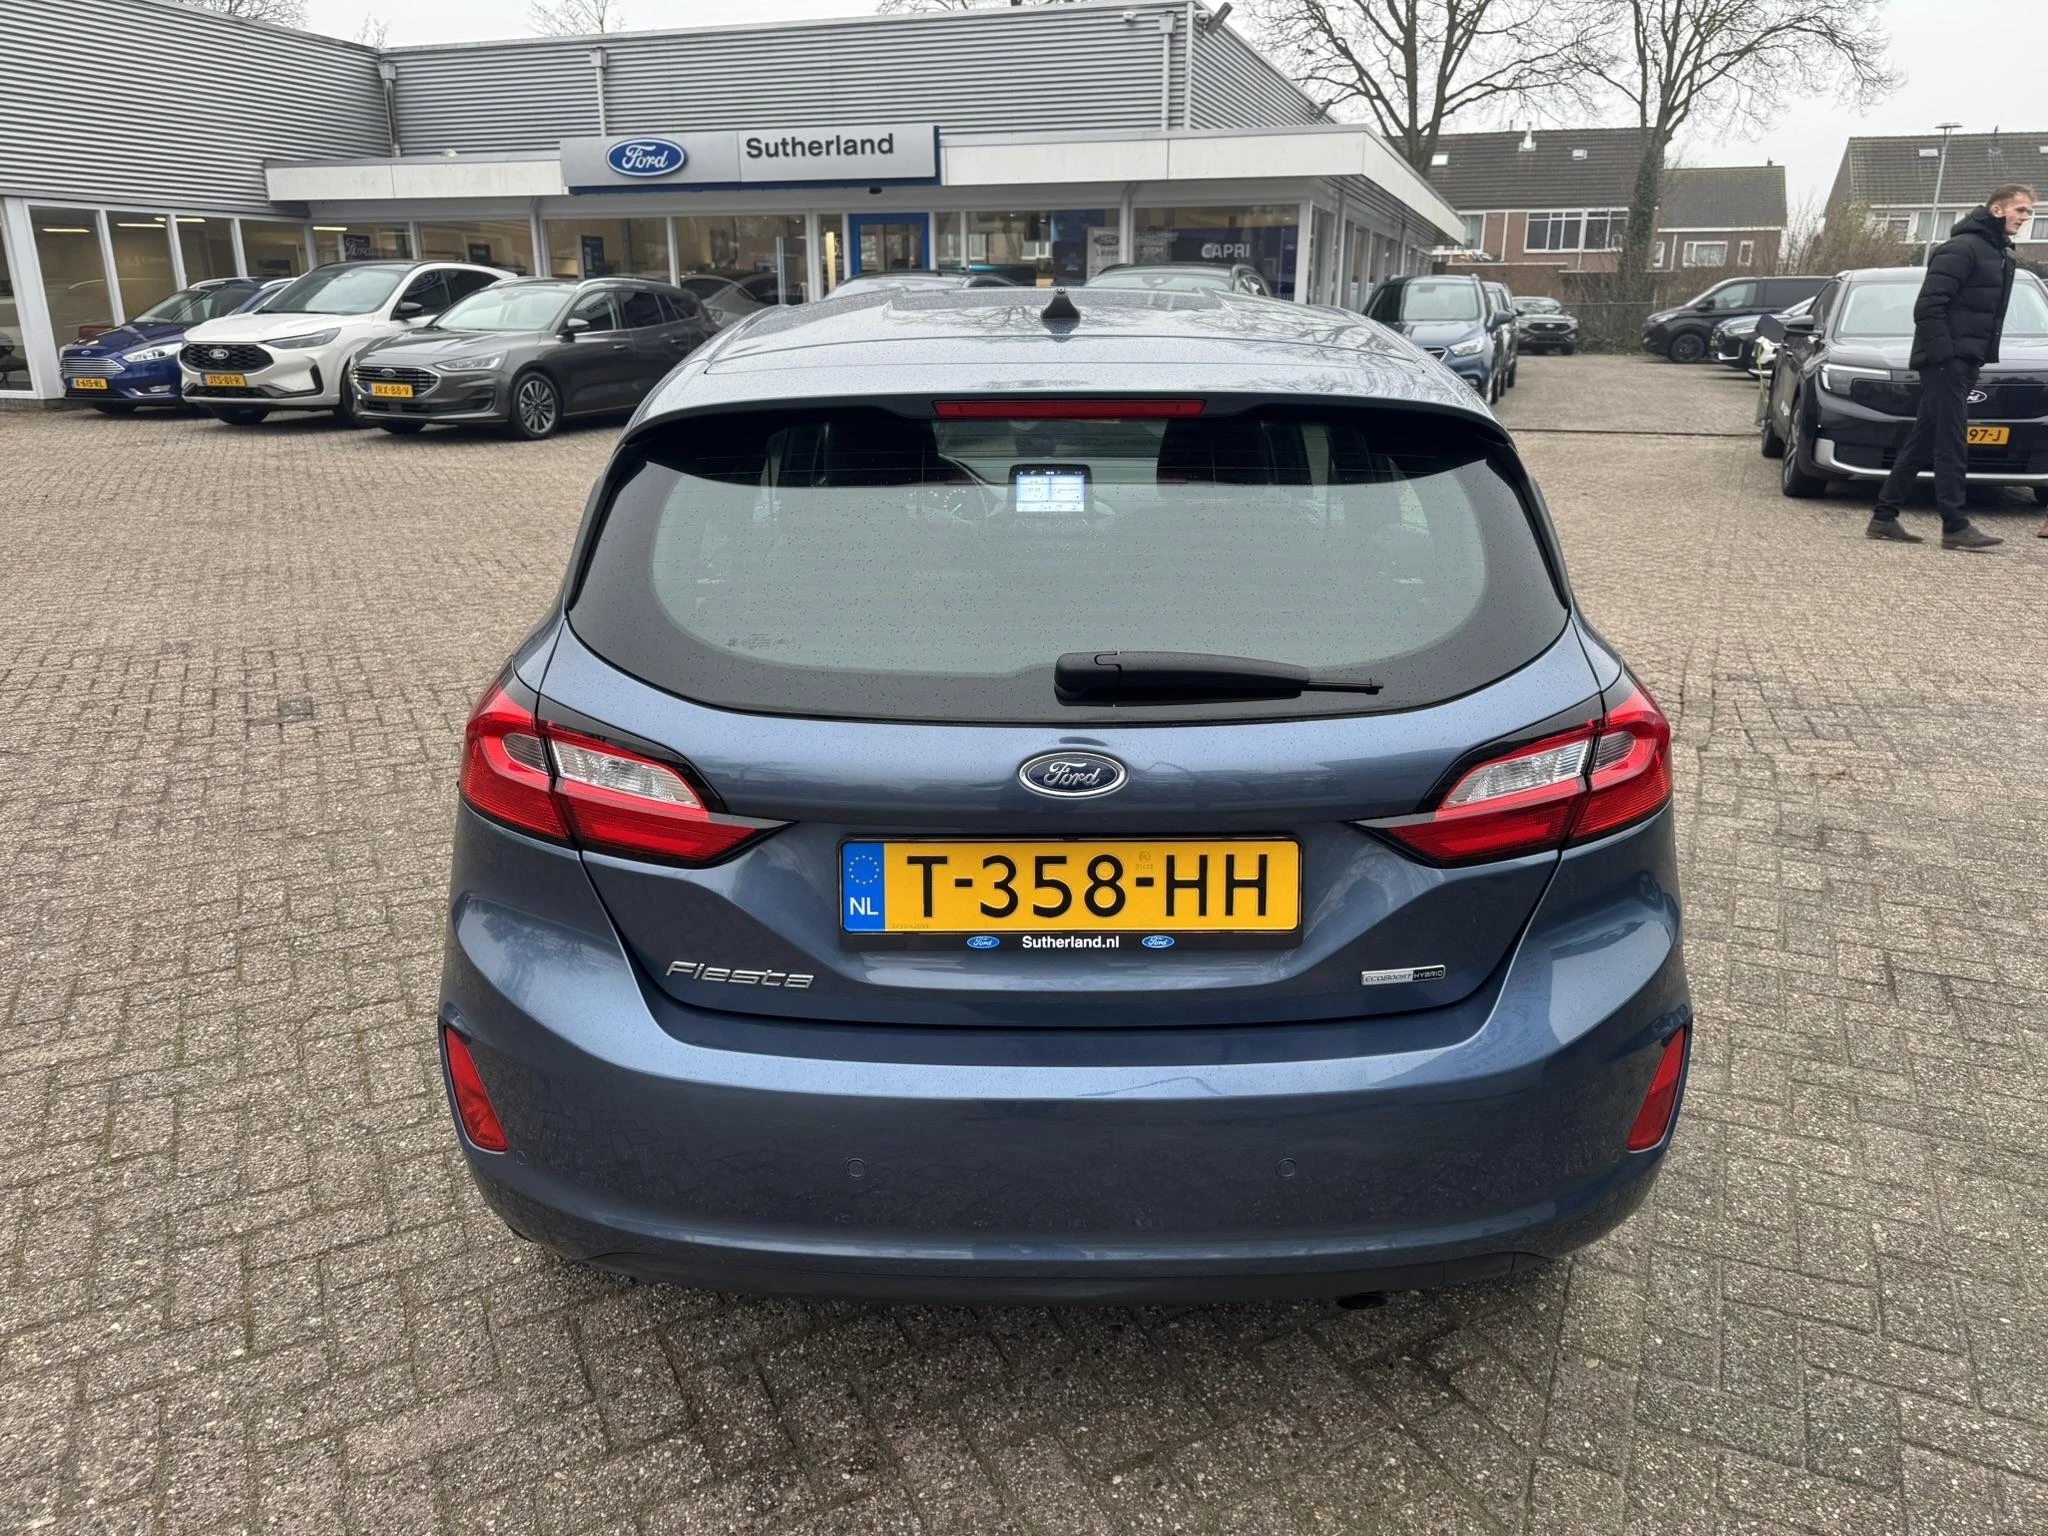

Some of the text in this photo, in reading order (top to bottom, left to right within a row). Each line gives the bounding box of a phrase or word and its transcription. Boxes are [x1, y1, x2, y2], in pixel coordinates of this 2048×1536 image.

[745, 132, 895, 159] Sutherland
[1201, 242, 1251, 259] CAPRI
[1969, 428, 2002, 442] 97-J
[1043, 760, 1101, 786] Ford
[906, 853, 1268, 918] T-358-HH
[849, 896, 879, 916] NL
[1022, 935, 1120, 949] Sutherland.nl
[665, 960, 815, 989] Fiesta
[1413, 969, 1444, 980] HYBRID
